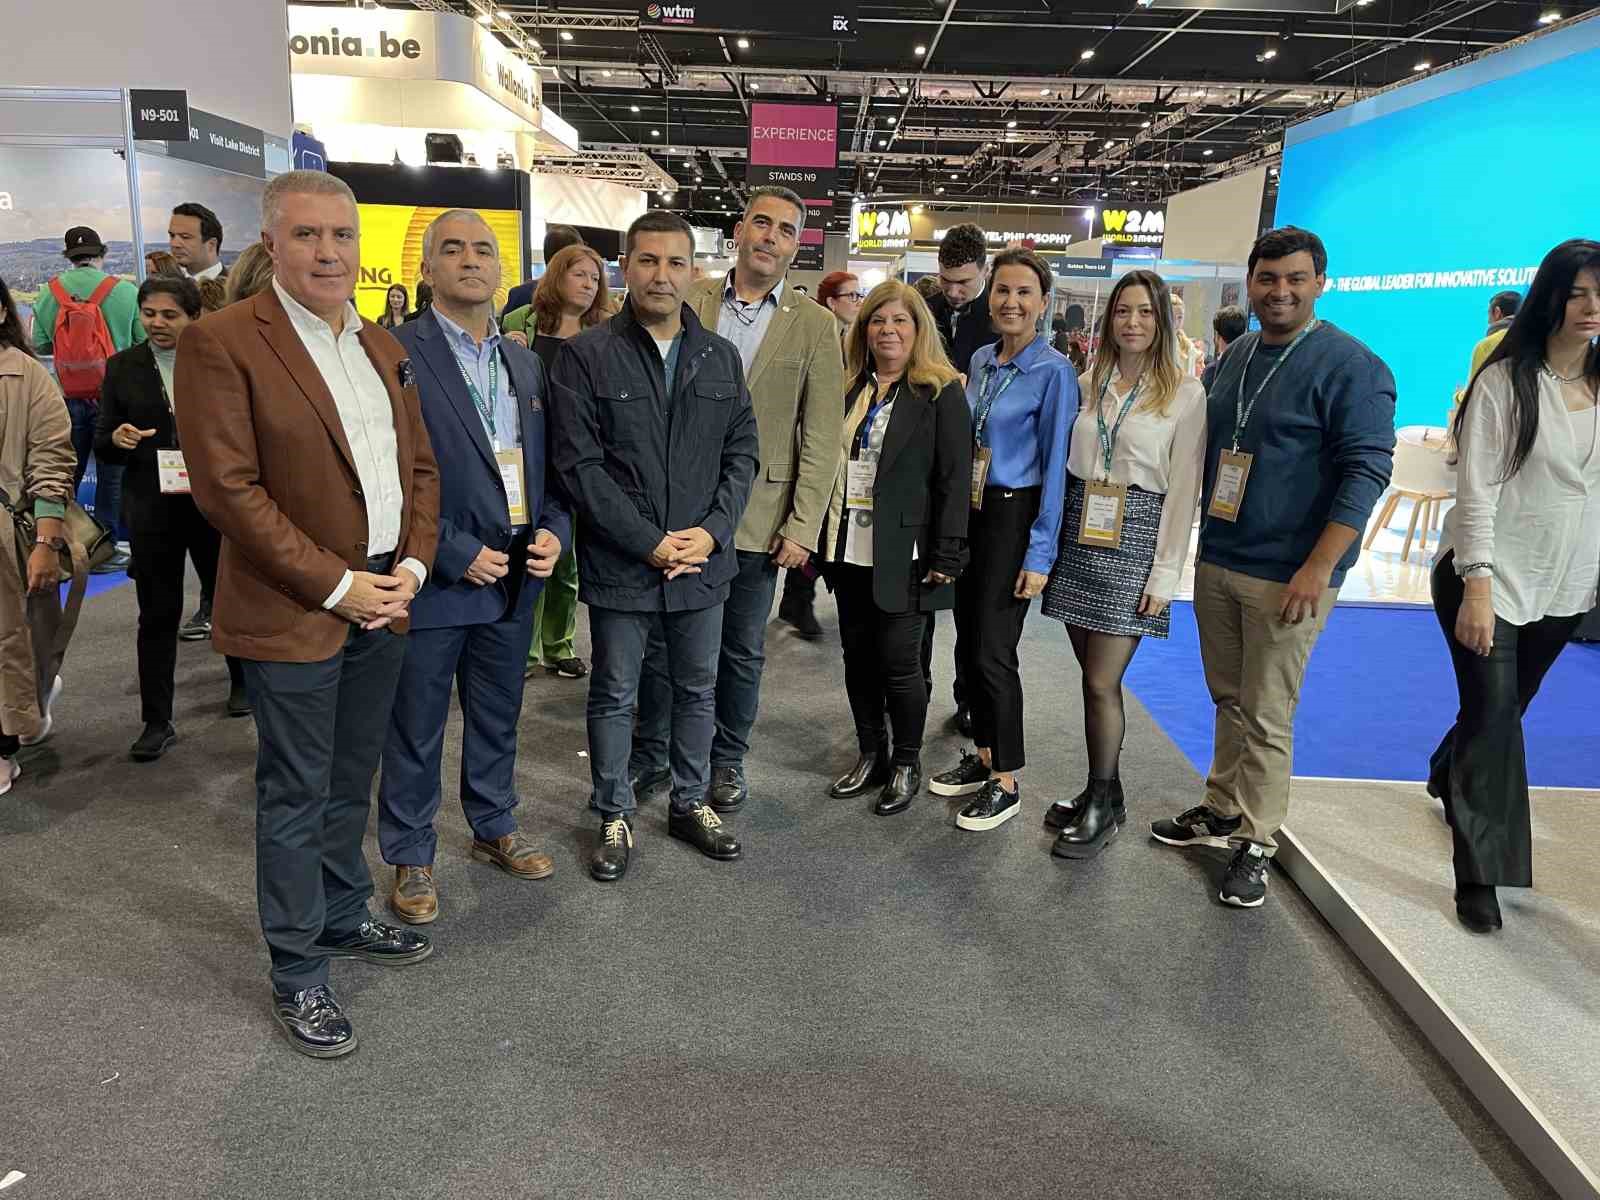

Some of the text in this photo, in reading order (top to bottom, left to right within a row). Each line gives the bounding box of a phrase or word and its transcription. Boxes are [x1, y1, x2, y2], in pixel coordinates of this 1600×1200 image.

[662, 4, 695, 18] wtm
[832, 20, 849, 31] RX
[140, 108, 180, 122] N9-501
[753, 126, 836, 142] EXPERIENCE
[239, 143, 260, 157] District
[768, 171, 817, 182] STANDS N9
[808, 209, 821, 217] N10
[857, 209, 911, 237] W2M
[1102, 209, 1165, 233] W2M
